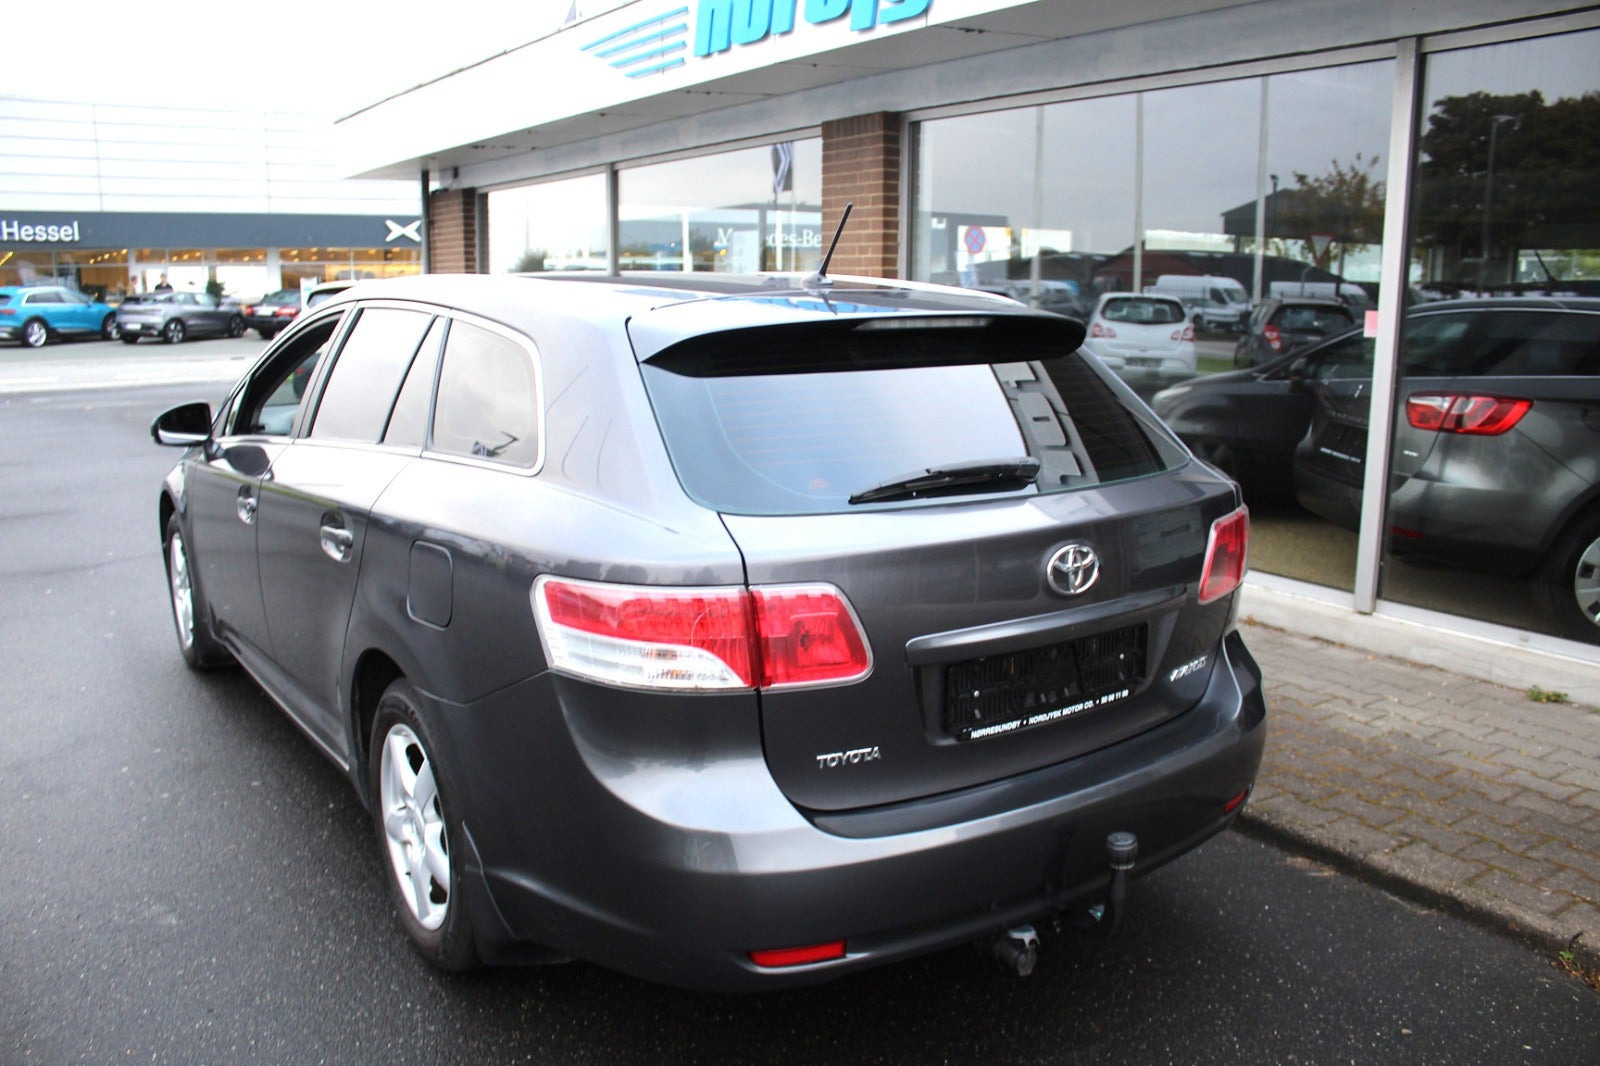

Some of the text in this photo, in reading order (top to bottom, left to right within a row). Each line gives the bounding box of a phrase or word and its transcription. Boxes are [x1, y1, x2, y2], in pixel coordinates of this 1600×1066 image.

[1, 220, 80, 242] Hessel
[1062, 703, 1084, 716] MOTOR
[816, 746, 881, 769] TOYOTA
